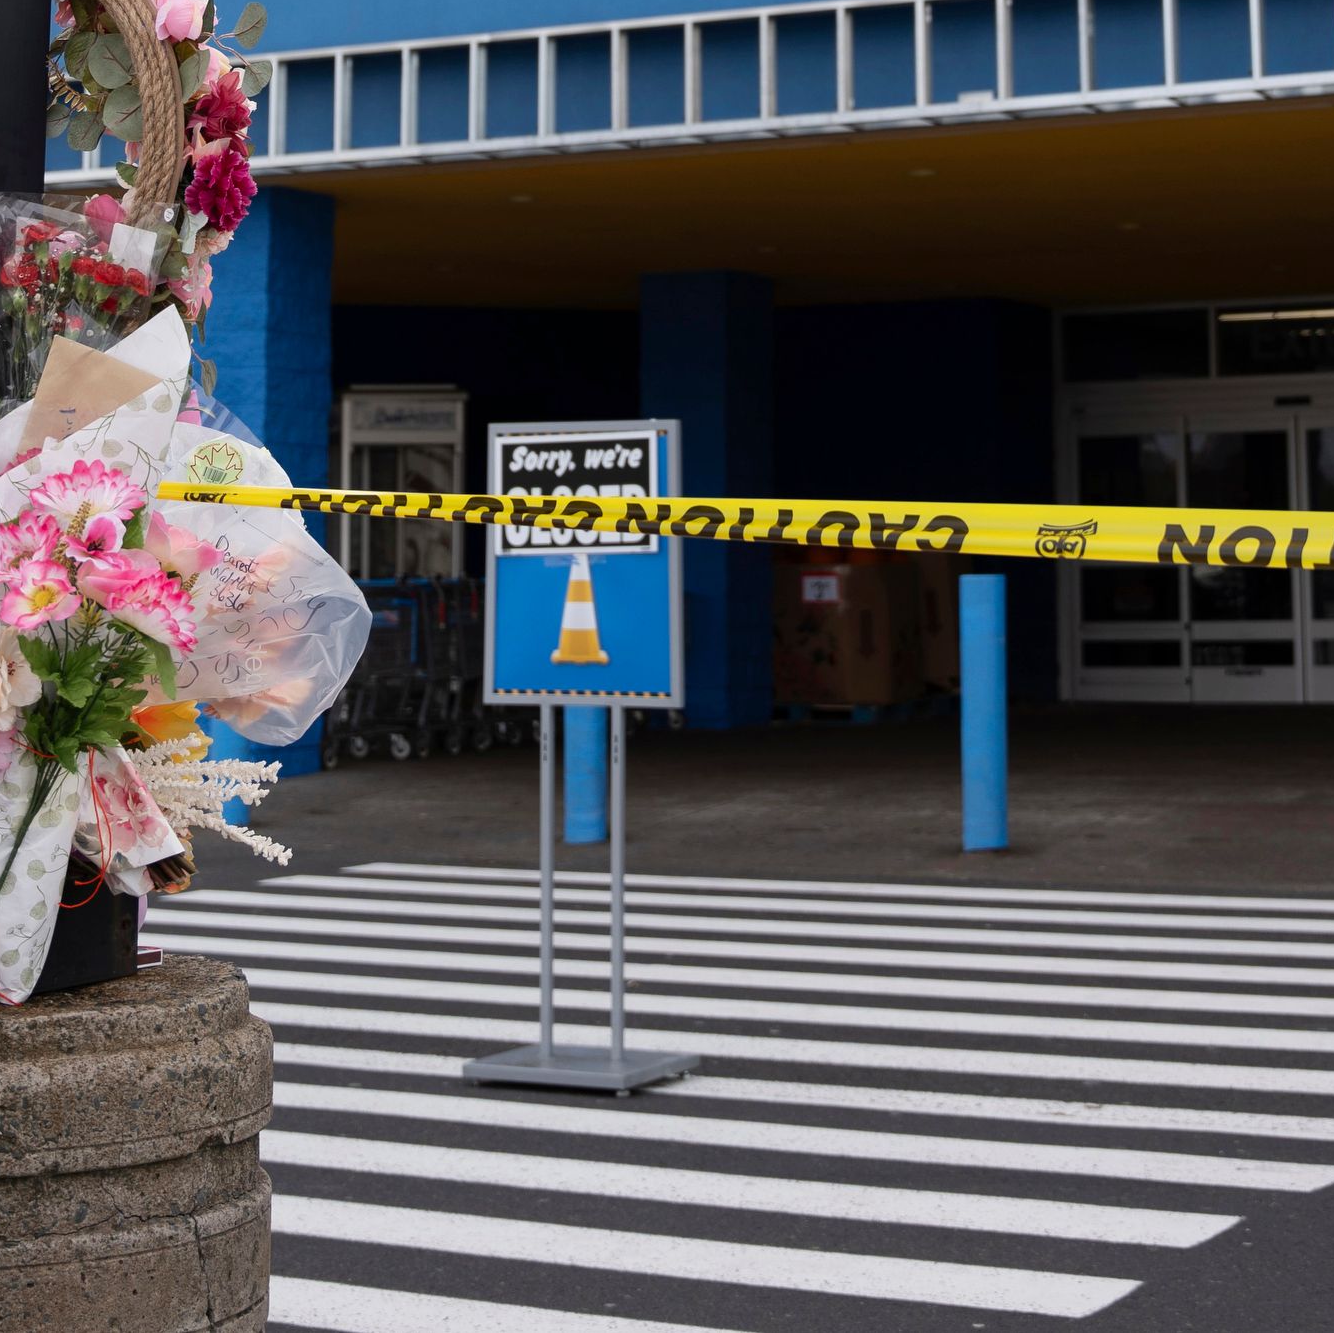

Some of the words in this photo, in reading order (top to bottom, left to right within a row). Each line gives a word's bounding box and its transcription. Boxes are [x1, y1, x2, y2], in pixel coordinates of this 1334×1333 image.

[509, 445, 576, 477] Sorry,
[584, 443, 643, 469] we're
[280, 493, 604, 532] CAUTION
[615, 502, 970, 553] CAUTION
[215, 534, 259, 574] Dearest
[210, 588, 245, 613] 3636
